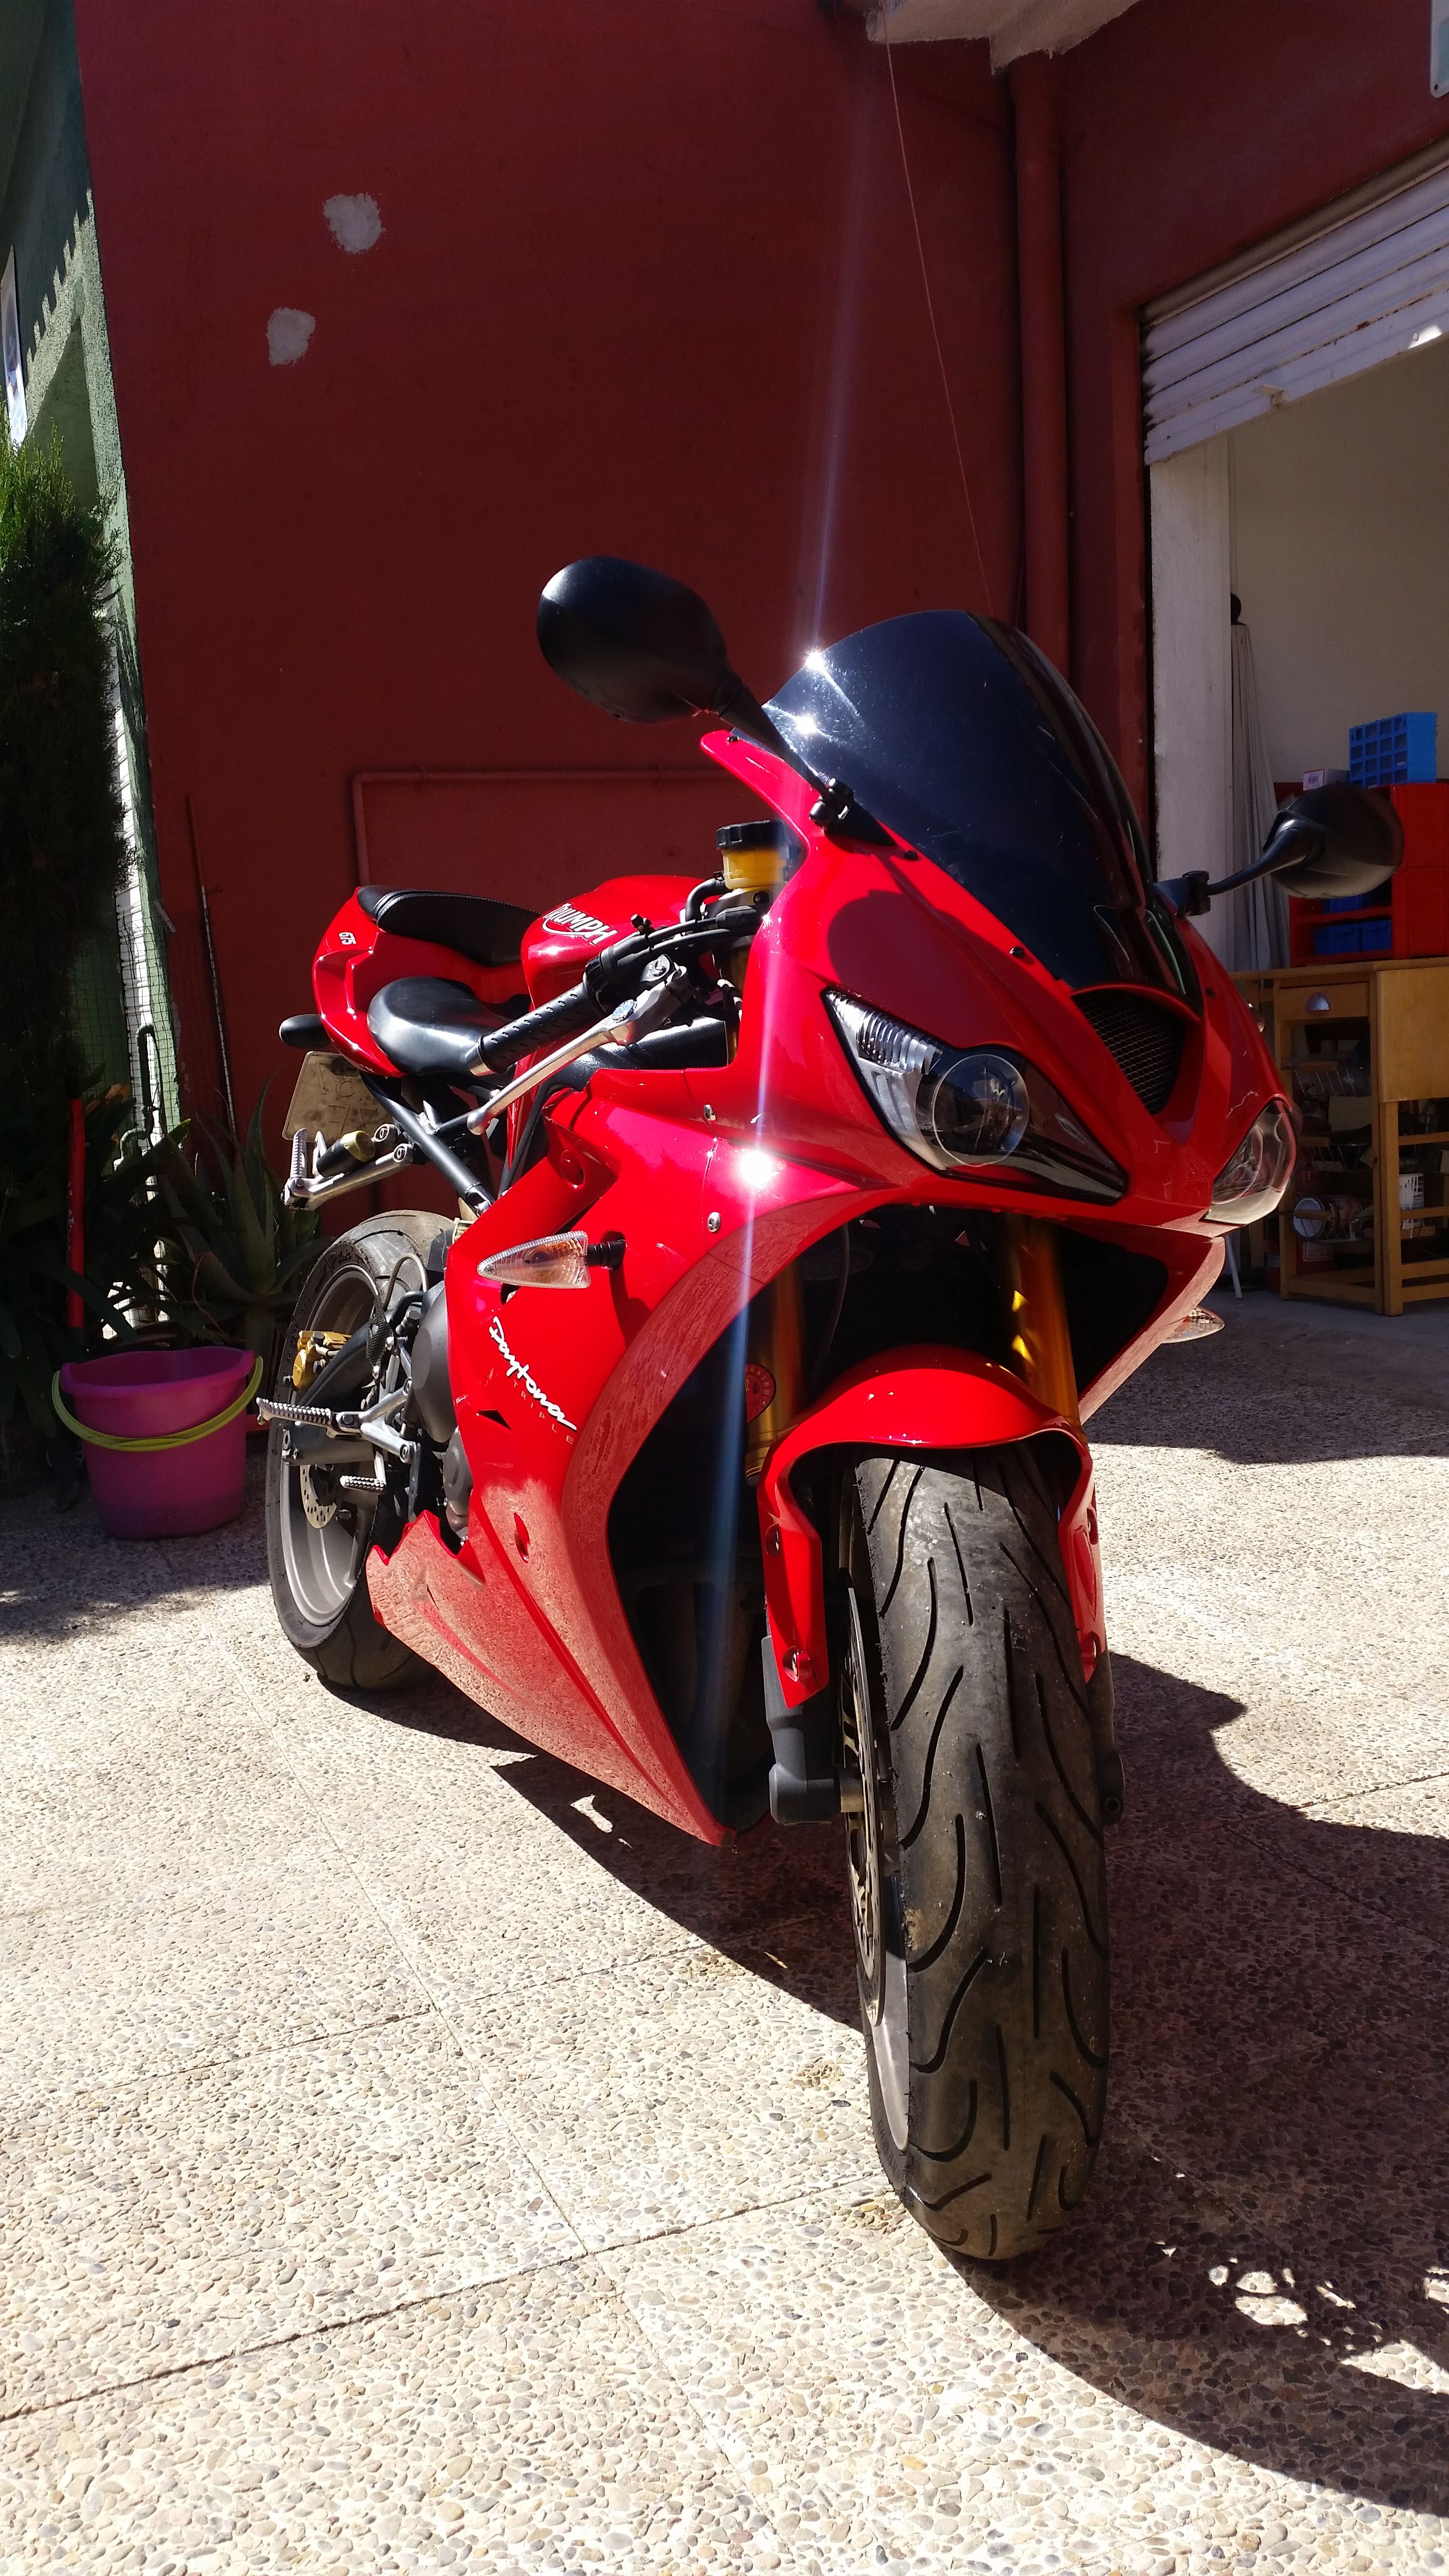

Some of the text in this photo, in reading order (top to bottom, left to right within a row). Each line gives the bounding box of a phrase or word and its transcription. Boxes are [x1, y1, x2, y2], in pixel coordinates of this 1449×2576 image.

[338, 932, 357, 945] 675
[542, 902, 619, 945] TRIUMPH
[489, 1316, 578, 1431] Daytona
[514, 1379, 574, 1445] TRIPLE
